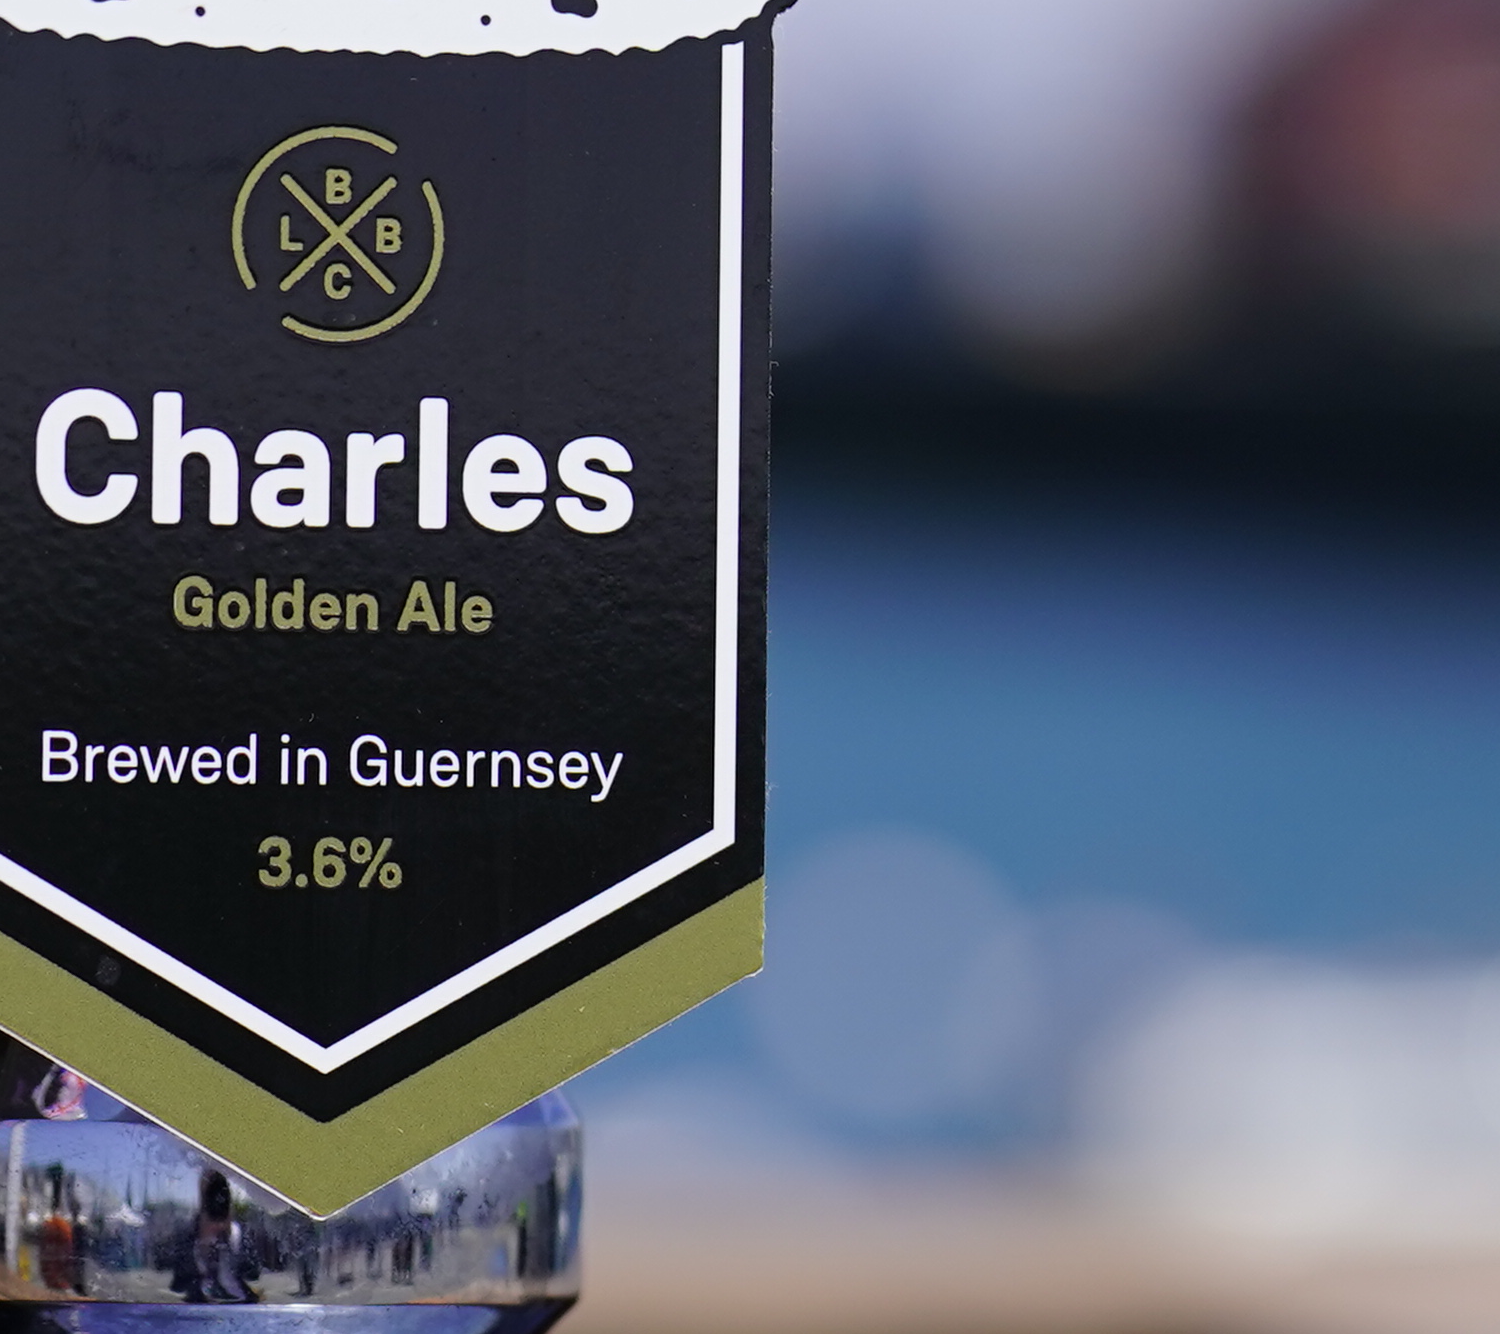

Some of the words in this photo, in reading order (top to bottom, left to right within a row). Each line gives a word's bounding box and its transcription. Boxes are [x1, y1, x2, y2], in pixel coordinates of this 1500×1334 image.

[326, 169, 351, 204] B
[281, 216, 303, 251] L
[376, 219, 402, 253] B
[324, 264, 351, 299] C
[36, 388, 633, 533] Charles
[174, 576, 378, 630] Golden
[397, 581, 492, 632] Ale
[42, 730, 257, 784] Brewed
[281, 734, 327, 785] in
[350, 734, 623, 802] Guernsey
[259, 836, 402, 888] 3.6%
